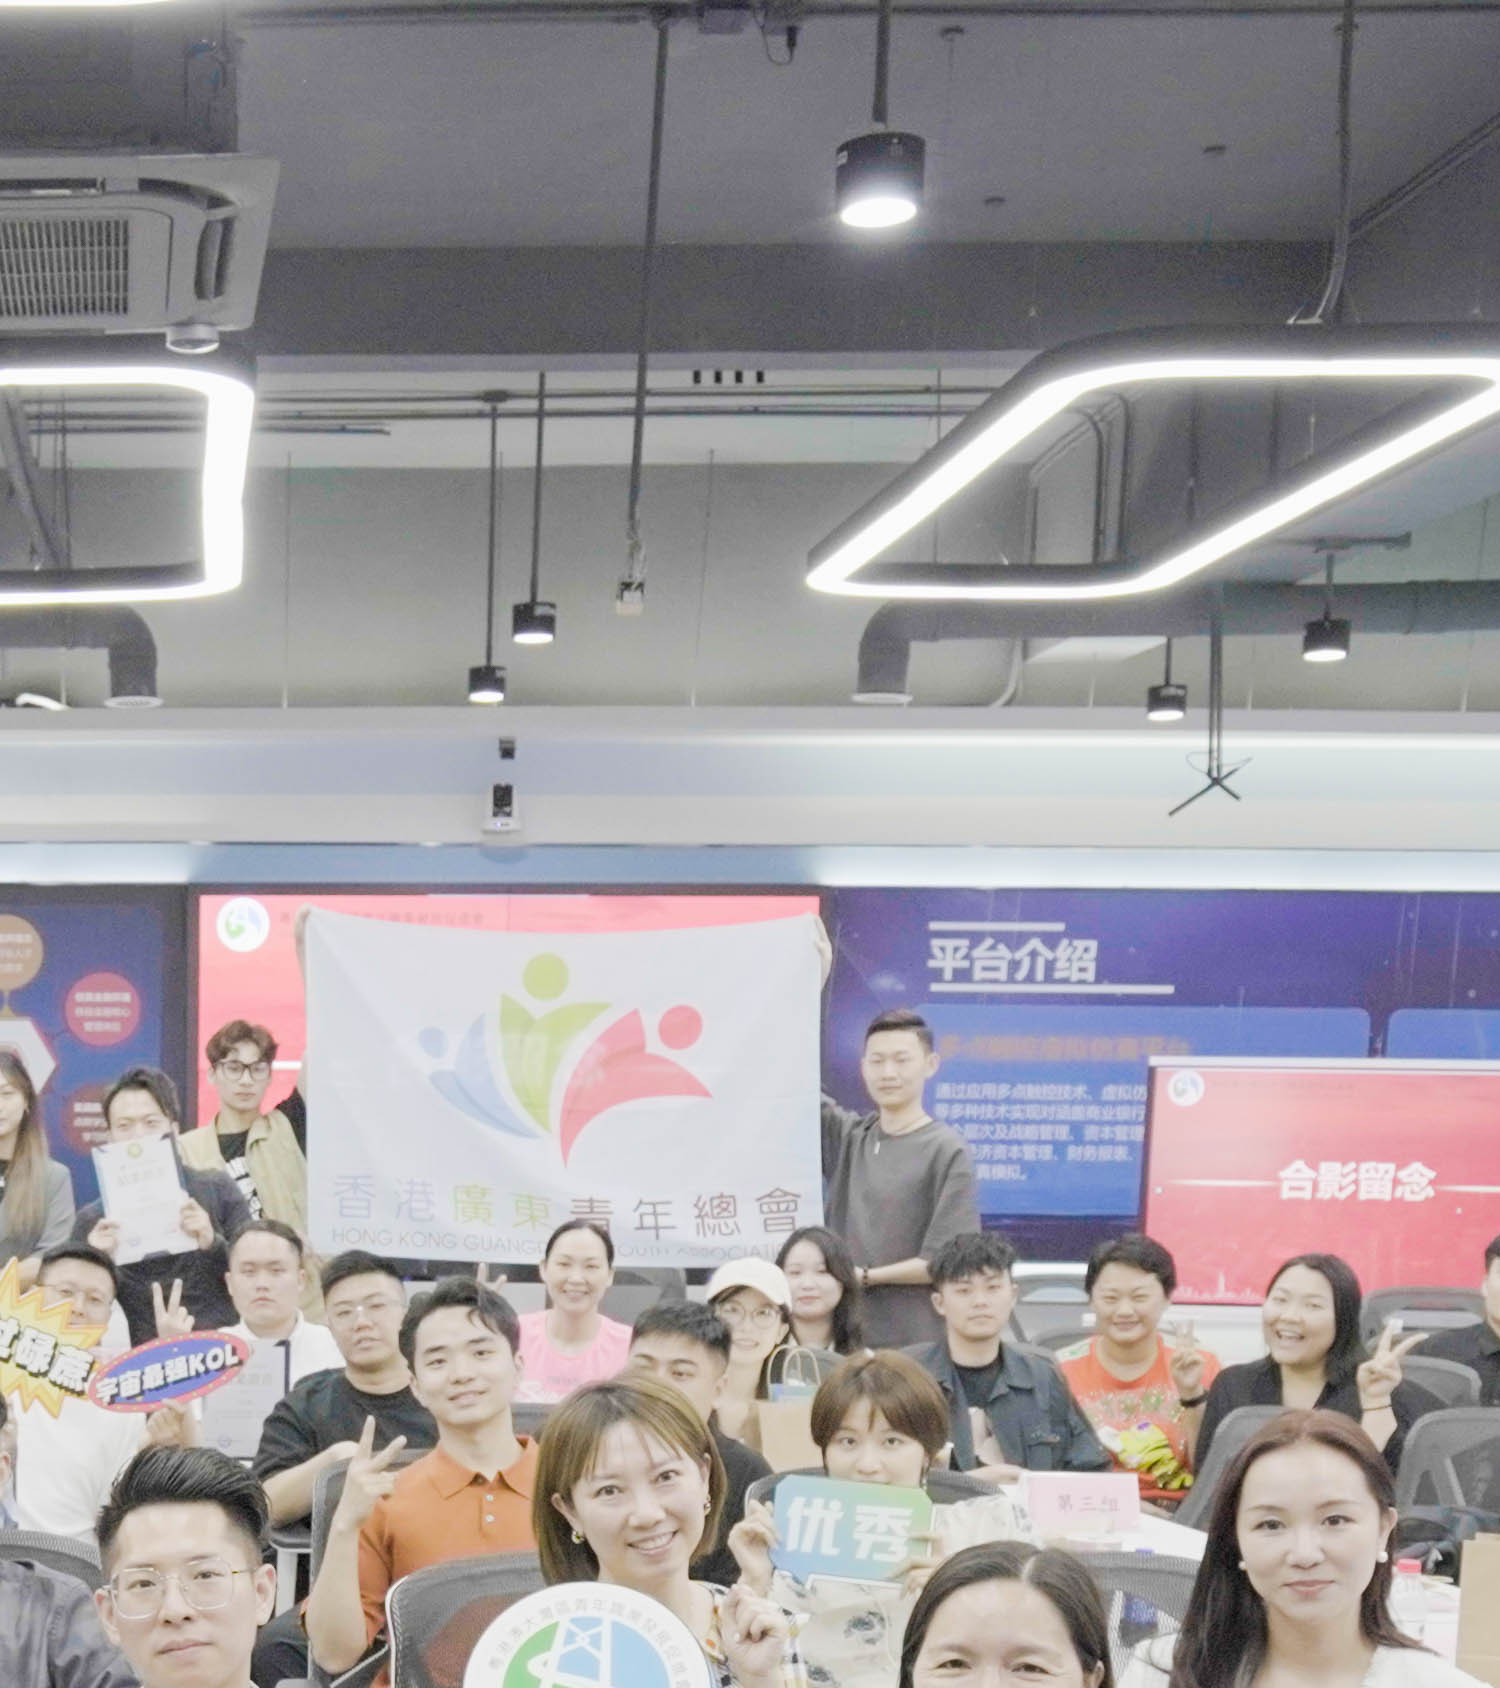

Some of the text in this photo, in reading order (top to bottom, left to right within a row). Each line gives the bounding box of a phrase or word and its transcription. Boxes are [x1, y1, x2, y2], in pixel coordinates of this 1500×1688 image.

[927, 938, 1099, 984] 平台介绍
[1278, 1160, 1437, 1202] 合影留念
[333, 1174, 802, 1242] 香港廣東青年總會
[331, 1224, 393, 1247] HONG
[399, 1231, 457, 1249] KONG
[786, 1496, 918, 1560] 优秀
